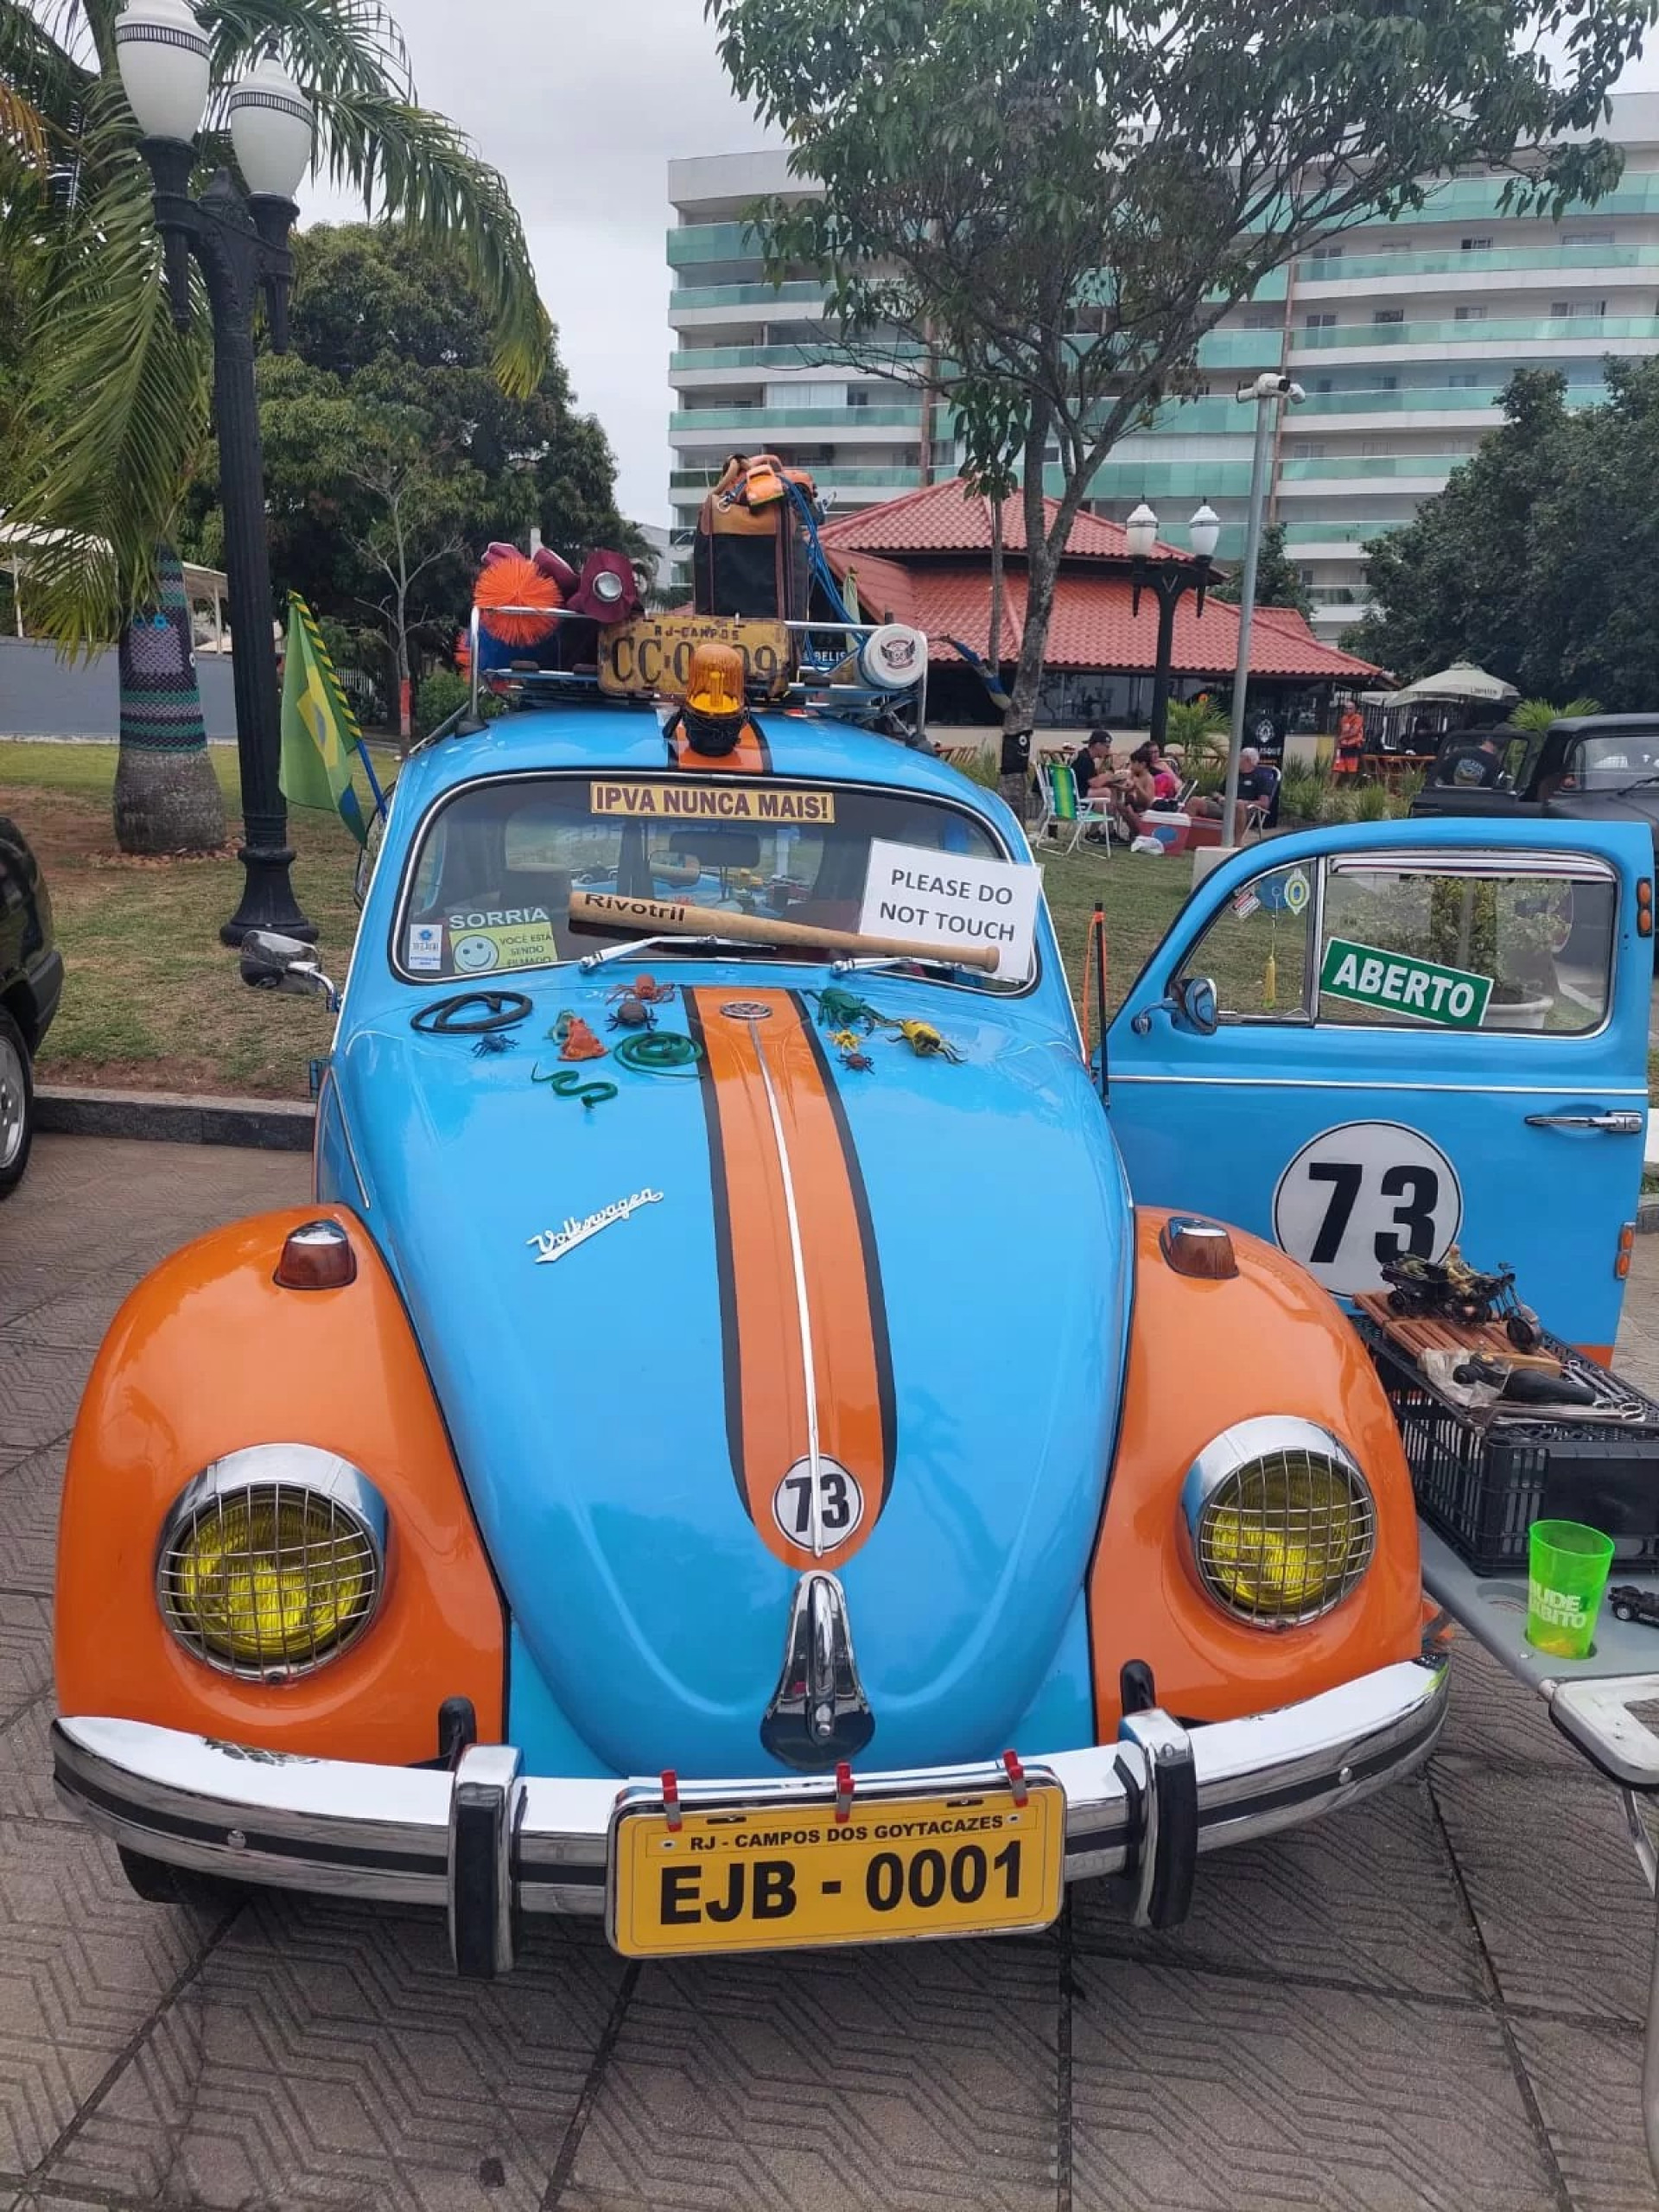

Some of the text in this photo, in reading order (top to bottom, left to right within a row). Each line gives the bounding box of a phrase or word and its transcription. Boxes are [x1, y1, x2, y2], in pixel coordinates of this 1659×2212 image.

[596, 786, 829, 819] IPVA NUNCA MAIS!
[891, 868, 1013, 906] PLEASE DO
[448, 907, 550, 929] SORRIA
[584, 893, 686, 923] Rivotril
[880, 901, 1015, 942] NOT TOUCH
[1332, 954, 1476, 1019] ABERTO
[526, 1187, 664, 1263] Volkswagen
[1308, 1163, 1440, 1263] 73
[785, 1474, 850, 1534] 73
[690, 1835, 716, 1851] RJ
[734, 1829, 821, 1849] CAMPOS
[827, 1826, 868, 1842] DOS
[875, 1815, 1003, 1840] GOYTACAZES
[660, 1860, 797, 1925] EJB
[866, 1840, 1021, 1913] 0001
